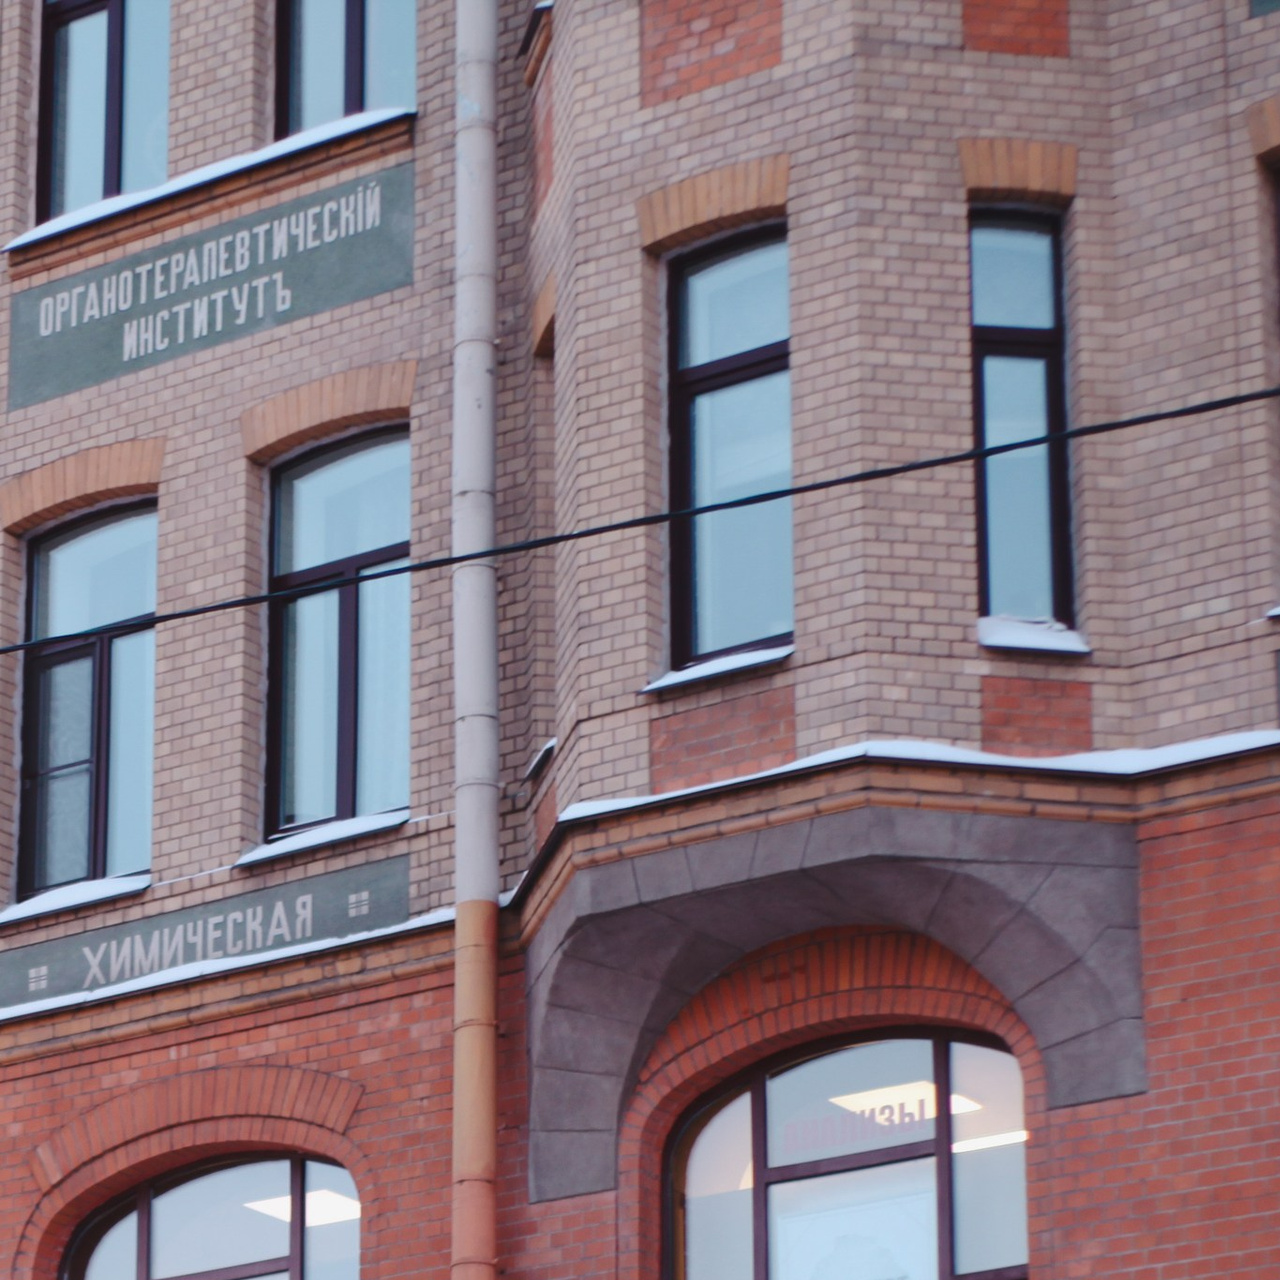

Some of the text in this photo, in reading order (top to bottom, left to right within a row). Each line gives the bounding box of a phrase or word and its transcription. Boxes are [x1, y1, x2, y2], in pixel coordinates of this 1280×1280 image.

[39, 181, 381, 337] ОРГАНОТЕРАПЕВТИЧЕСКІЙ
[123, 272, 291, 362] ИНСТИТУТЪ
[82, 894, 313, 988] ХИМИЧЕСКАЯ
